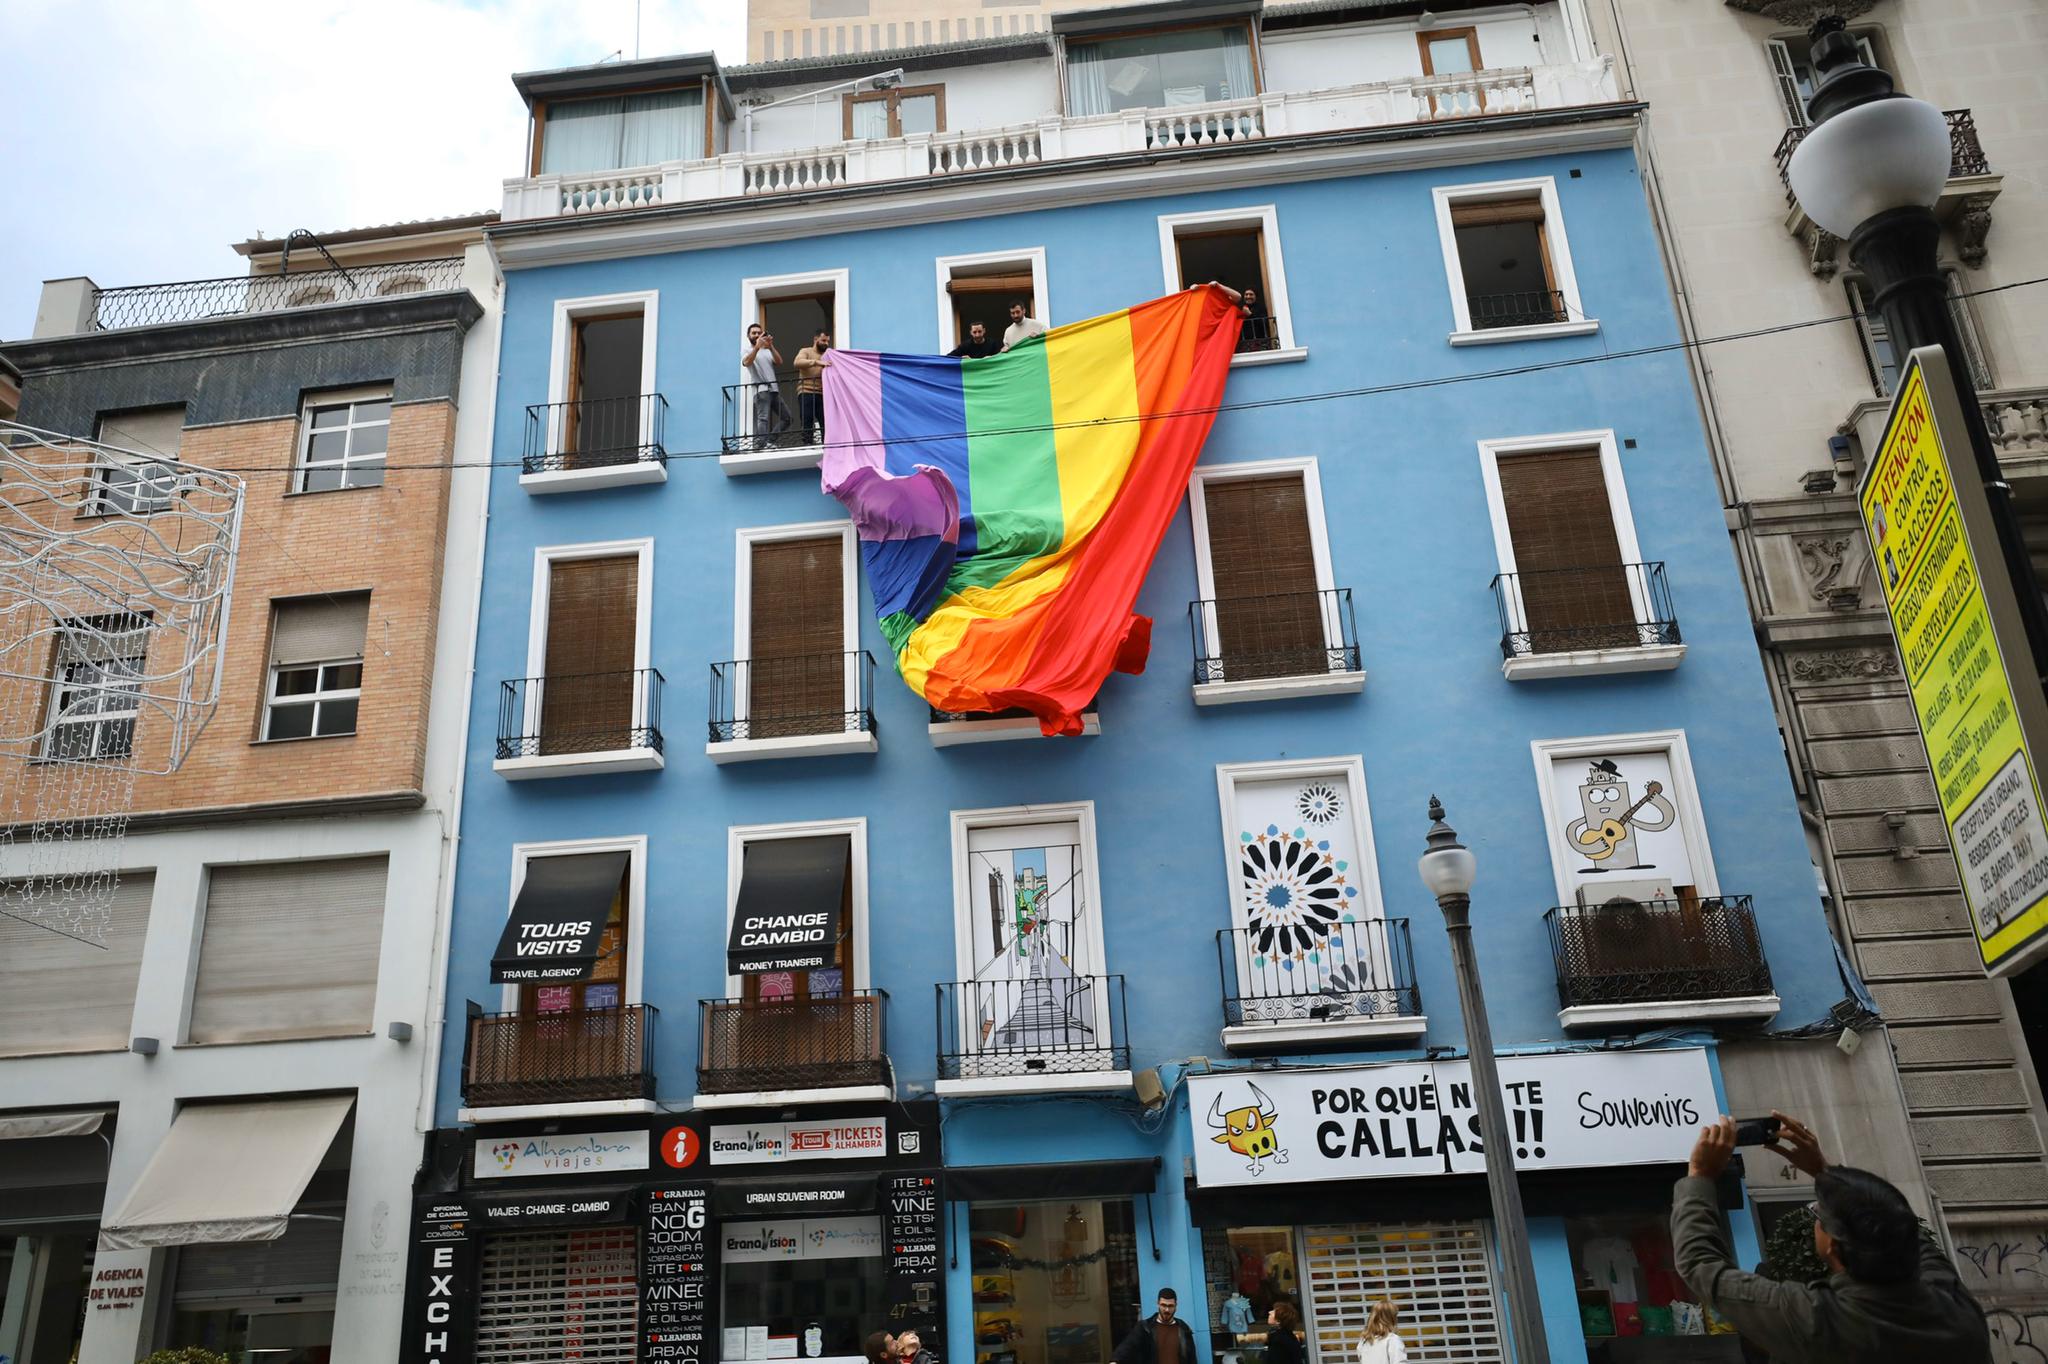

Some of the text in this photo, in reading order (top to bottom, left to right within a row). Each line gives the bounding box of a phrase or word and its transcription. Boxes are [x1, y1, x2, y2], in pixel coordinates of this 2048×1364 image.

[1881, 397, 1925, 512] ATENCIÓN
[1894, 451, 1929, 529] CONTROL
[1897, 469, 1943, 571] DE ACCESOS
[1899, 516, 1958, 638] ACCESO RESTRINGIDO
[1909, 559, 1971, 675] CALLE REYES CATÓLICOS
[1960, 769, 2024, 845] EXCEPTO BUS URBANO,
[2000, 798, 2030, 837] HOTELES
[1980, 872, 1993, 894] DEL
[2012, 840, 2028, 867] TAXI
[744, 912, 829, 930] CHANGE
[521, 921, 592, 938] TOURS
[740, 929, 825, 946] CAMBIO
[516, 940, 582, 956] VISITS
[740, 957, 822, 970] MONEY TRANSFER
[502, 968, 582, 979] TRAVEL AGENCY
[1312, 1075, 1543, 1115] POR QUÉ N TE
[1578, 1091, 1699, 1128] Souvenirs
[835, 1126, 882, 1140] TICKETS
[523, 1137, 630, 1157] Alhambra
[804, 1136, 822, 1146] TOUR
[835, 1140, 882, 1150] ALHAMBRA
[544, 1156, 603, 1169] viajes
[892, 1178, 916, 1188] ITE
[663, 1189, 706, 1198] GRANADA
[746, 1190, 844, 1204] URBAN SOUVENIR ROOM
[488, 1206, 520, 1216] VIAJES
[526, 1204, 566, 1215] CHANGE
[572, 1201, 610, 1212] CAMBIO
[649, 1202, 686, 1213] BAN
[652, 1214, 686, 1230] NO
[892, 1216, 912, 1224] TS
[426, 1230, 464, 1238] COMISIÓN
[904, 1226, 924, 1234] OIL
[96, 1268, 143, 1282] AGENCIA
[90, 1286, 144, 1300] DE VIAJES
[424, 1248, 454, 1364] EXCH
[890, 1304, 907, 1319] 47
[661, 1314, 680, 1322] OIL
[658, 1333, 702, 1342] ALHAMBRA
